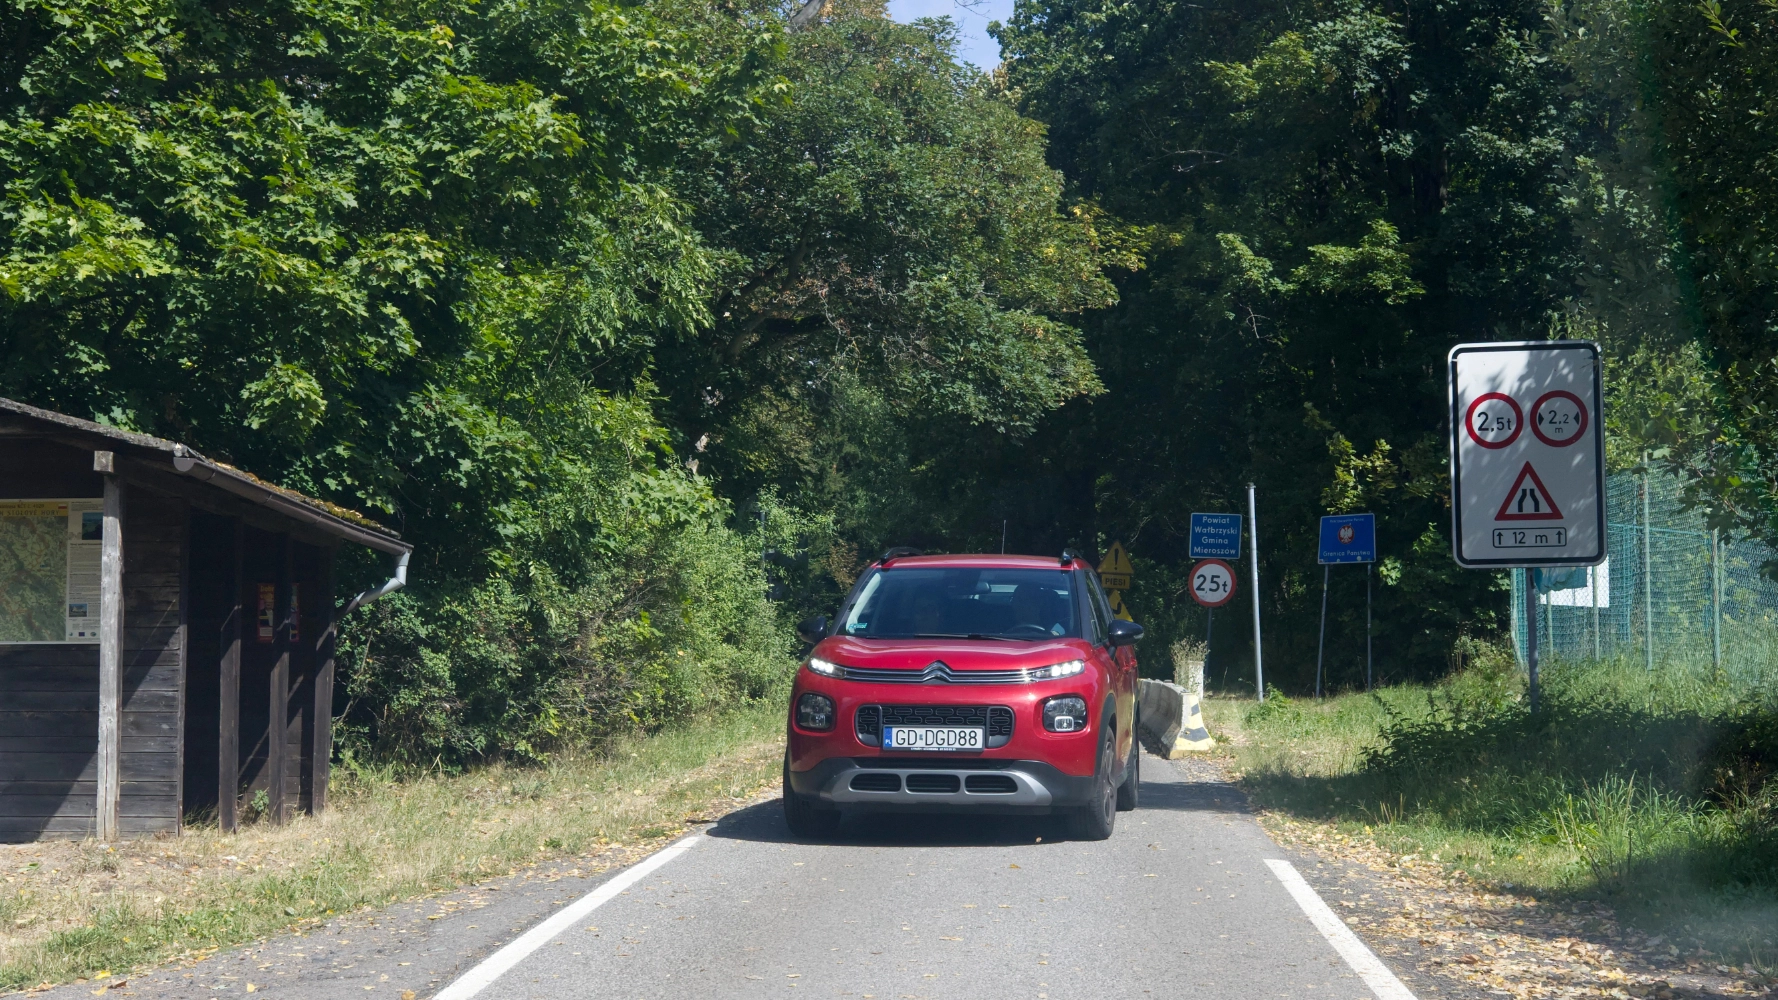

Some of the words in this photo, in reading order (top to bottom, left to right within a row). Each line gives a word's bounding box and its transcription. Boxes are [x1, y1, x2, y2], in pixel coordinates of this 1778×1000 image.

[1477, 411, 1512, 433] 2,5t
[1548, 409, 1570, 425] 2,2
[1202, 515, 1230, 524] Powiat
[1194, 526, 1238, 536] Wałbrzyski
[1201, 536, 1229, 545] Gmina
[1512, 531, 1526, 544] 12
[1534, 534, 1548, 544] m
[1193, 546, 1237, 555] Mieroszów
[1105, 577, 1126, 587] PIESI
[895, 729, 917, 746] GD
[924, 729, 977, 747] DGD88
